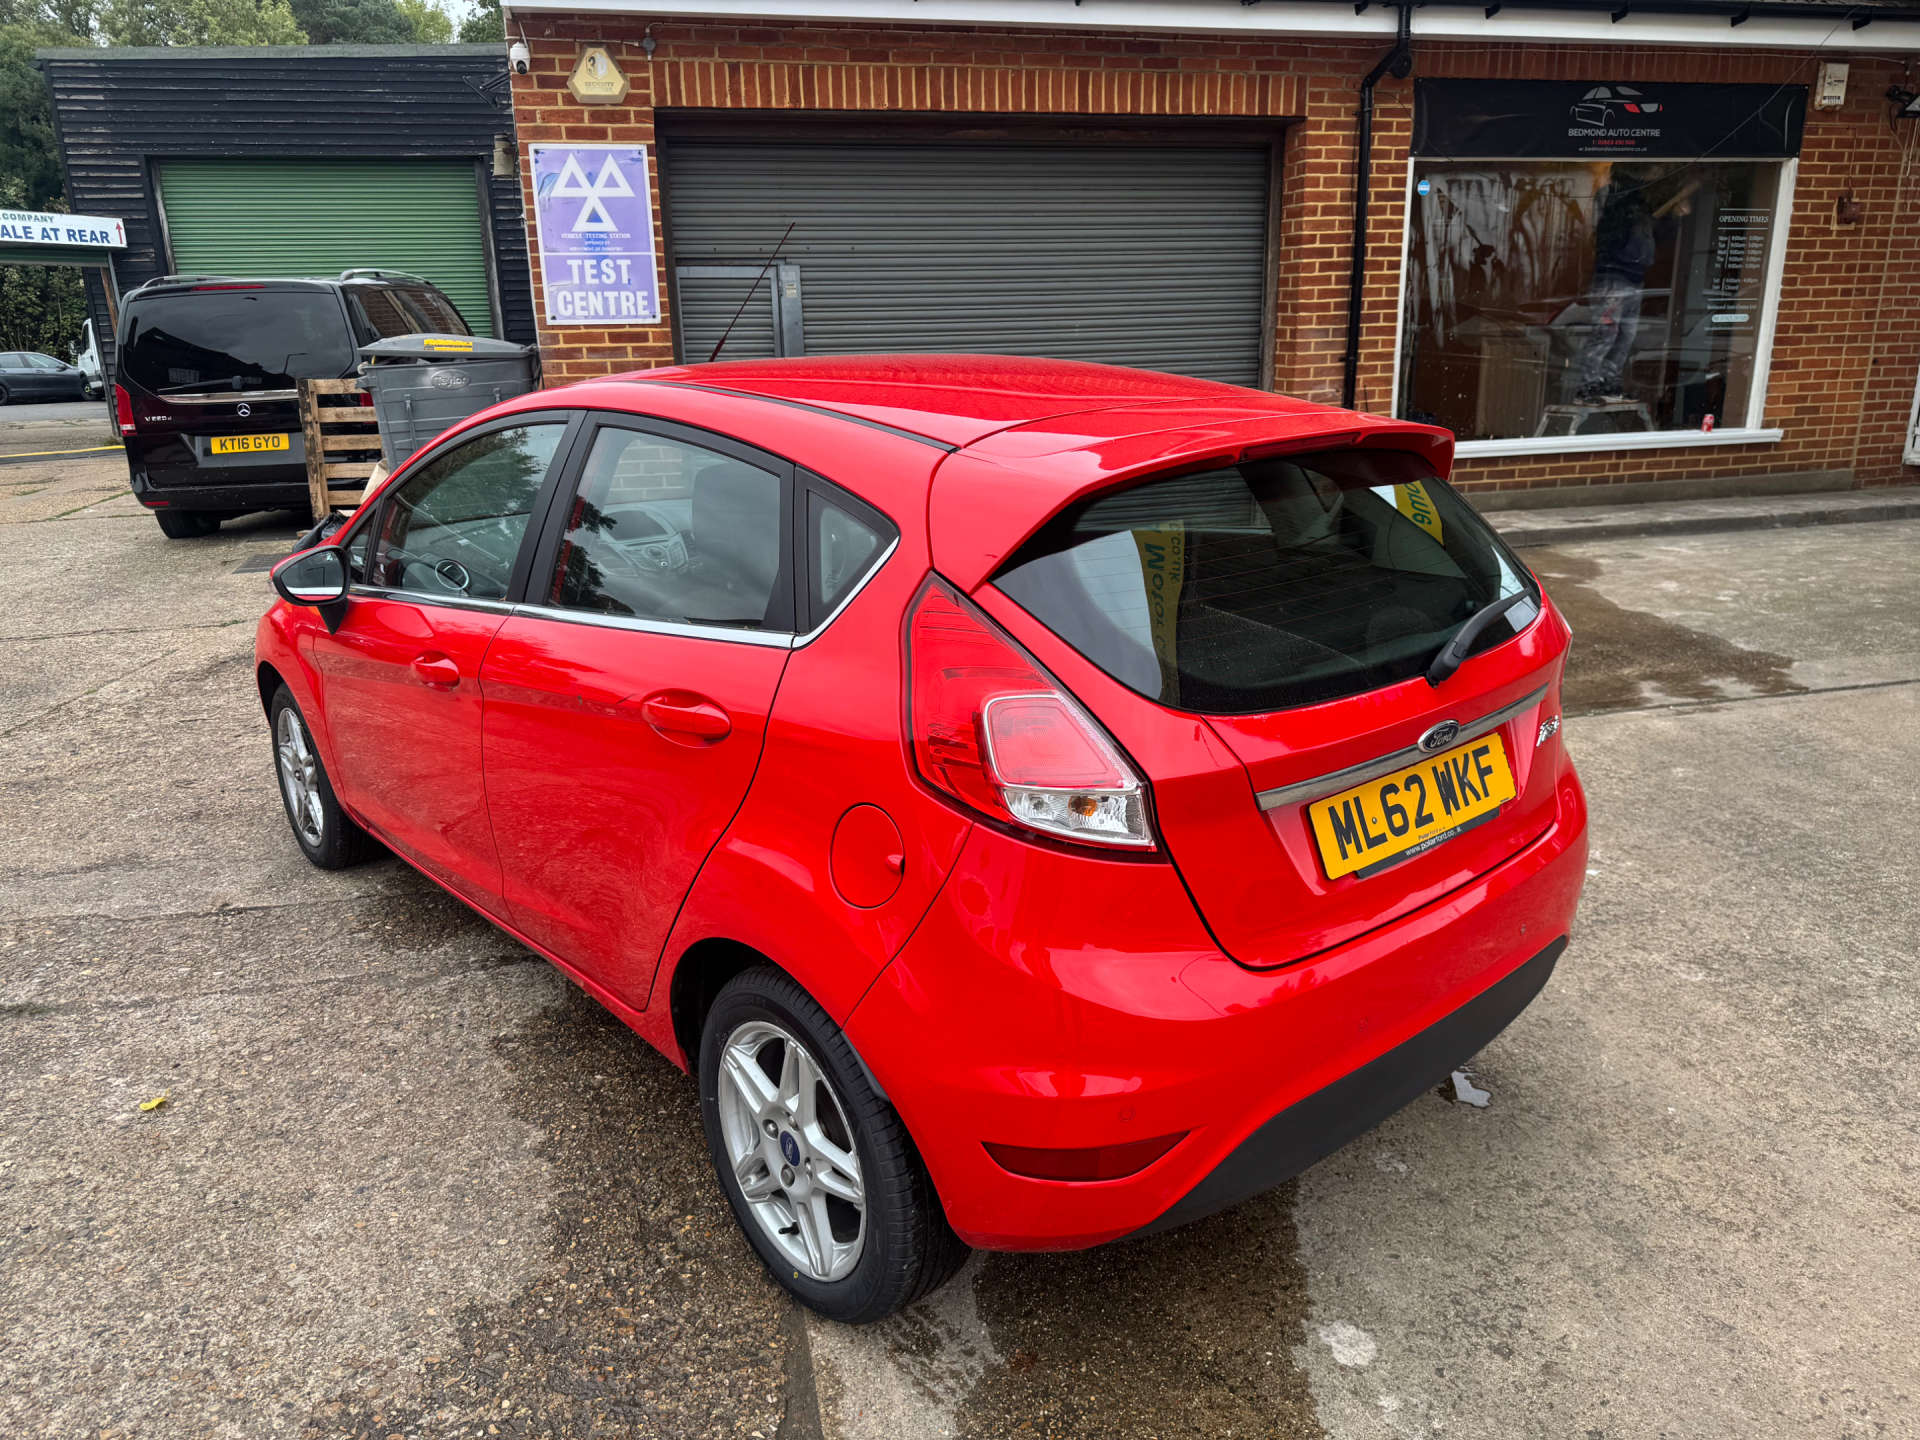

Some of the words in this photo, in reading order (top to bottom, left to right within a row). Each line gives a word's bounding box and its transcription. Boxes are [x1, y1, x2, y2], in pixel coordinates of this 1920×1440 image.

[1568, 128, 1607, 137] BEDMOND
[1608, 128, 1630, 137] AUTO
[1631, 128, 1661, 137] CENTRE
[2, 212, 54, 223] COMPANY
[1719, 215, 1748, 223] OPENING
[1749, 215, 1769, 223] TIMES
[41, 227, 60, 241] AT
[66, 228, 111, 244] REAR
[566, 258, 632, 285] TEST
[557, 290, 650, 317] CENTRE
[219, 438, 250, 451] KT16
[1428, 725, 1457, 749] Ford
[1328, 773, 1434, 861] ML62
[1431, 744, 1493, 816] WKF
[1405, 826, 1462, 856] www.polarford.co.k
